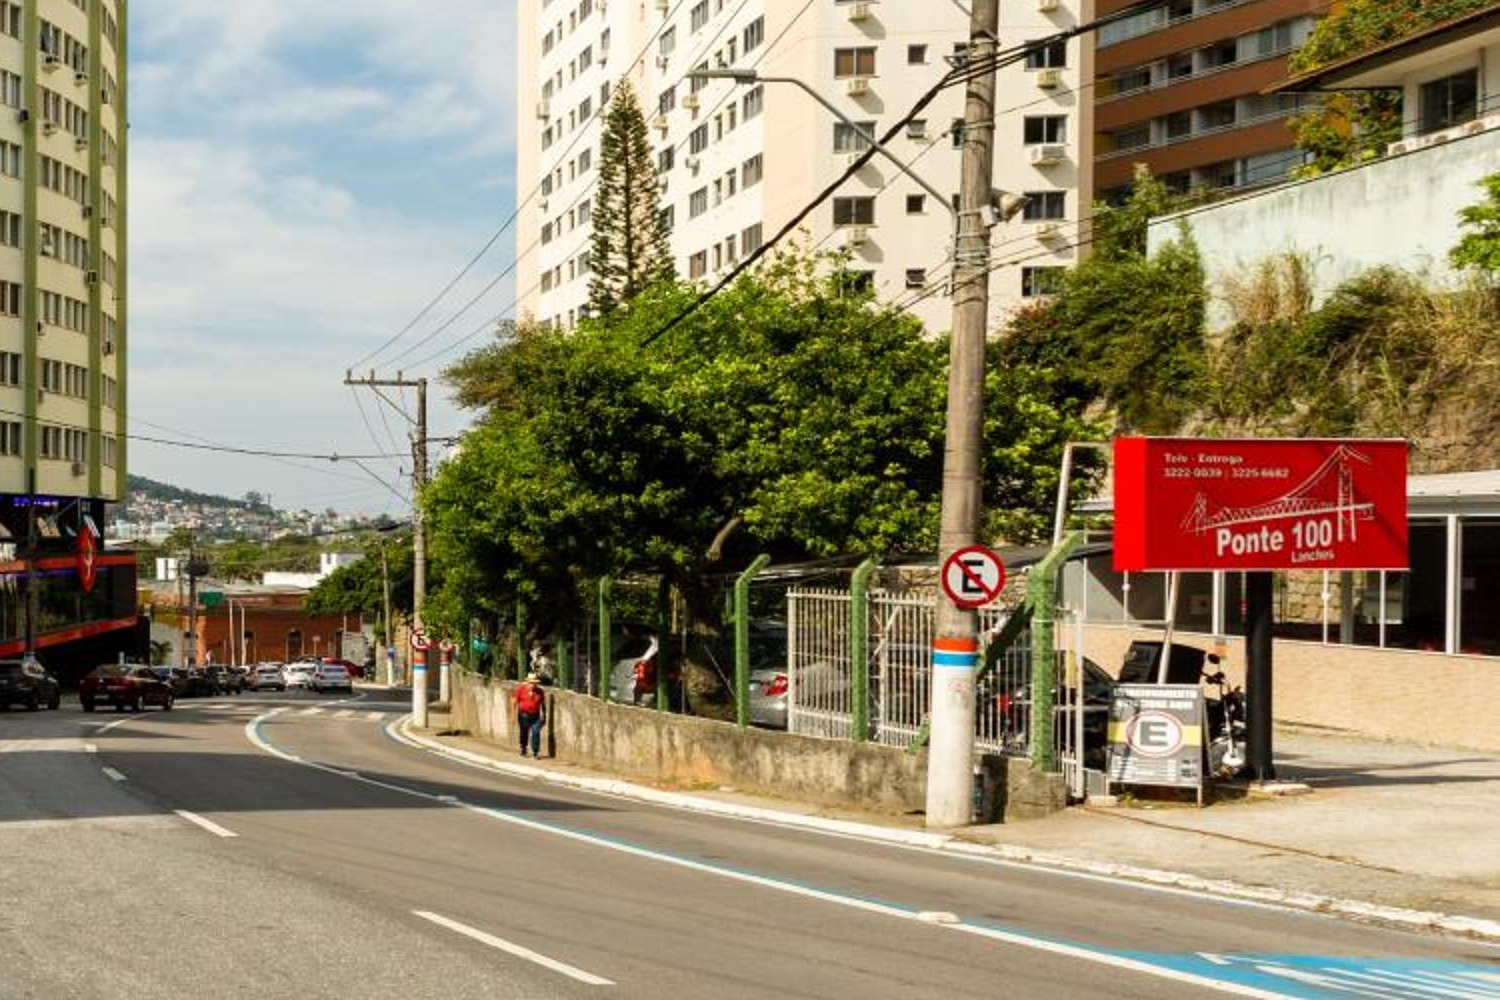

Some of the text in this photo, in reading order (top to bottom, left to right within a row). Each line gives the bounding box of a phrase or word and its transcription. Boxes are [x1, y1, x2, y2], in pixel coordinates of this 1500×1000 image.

[1217, 520, 1333, 556] Ponte 100
[1291, 549, 1335, 563] Lanches
[962, 560, 984, 593] E
[1140, 721, 1169, 747] E
